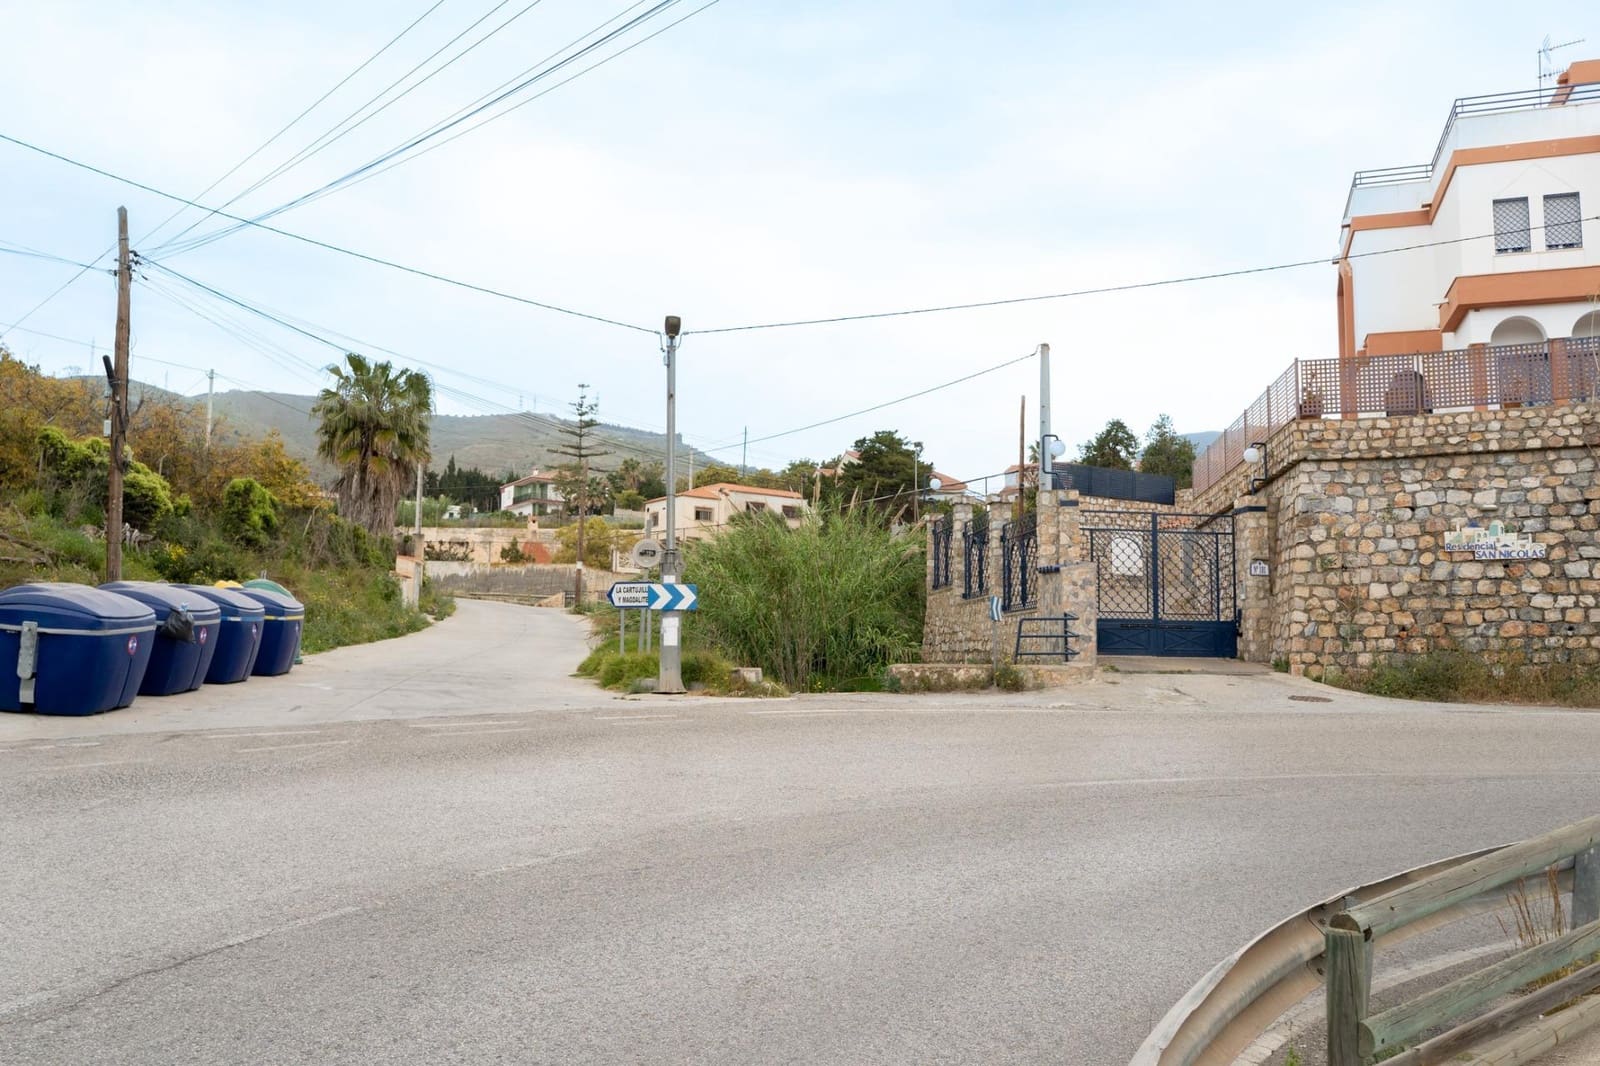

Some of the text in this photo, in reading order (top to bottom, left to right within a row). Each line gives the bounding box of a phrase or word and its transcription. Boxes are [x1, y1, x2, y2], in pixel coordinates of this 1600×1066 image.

[1445, 541, 1496, 551] Resdencial
[1475, 549, 1545, 559] SAN NICOLAS
